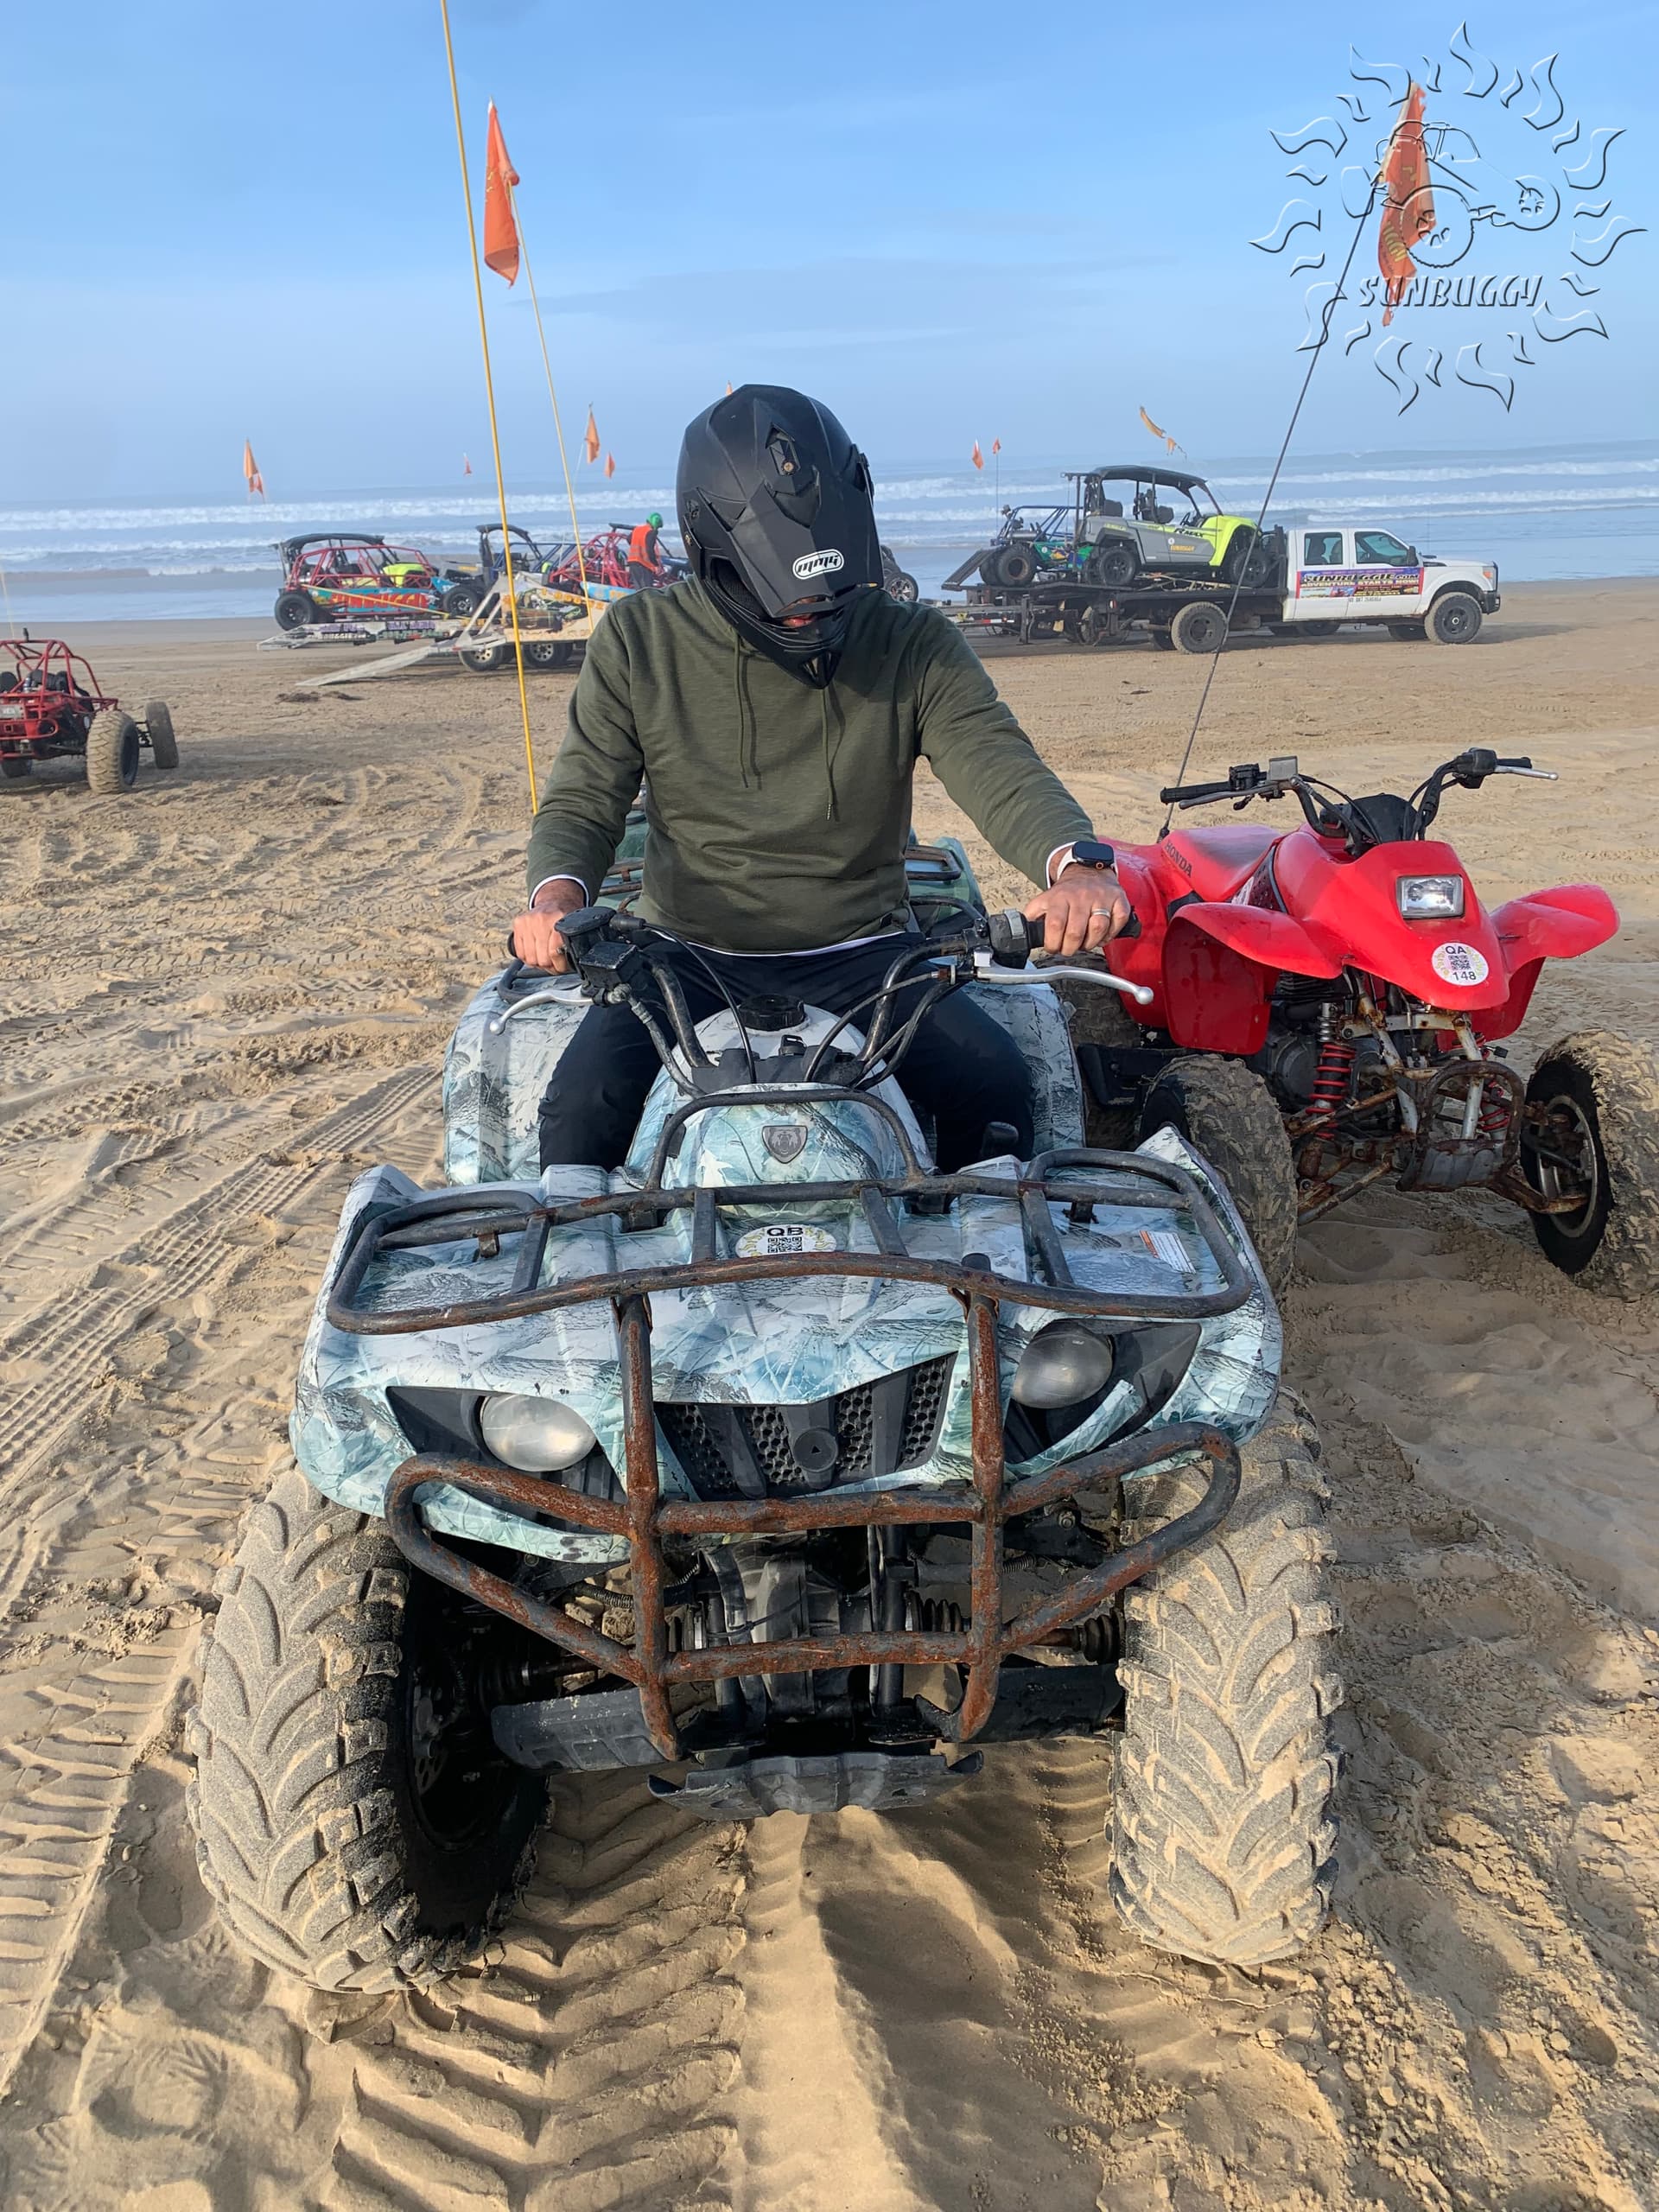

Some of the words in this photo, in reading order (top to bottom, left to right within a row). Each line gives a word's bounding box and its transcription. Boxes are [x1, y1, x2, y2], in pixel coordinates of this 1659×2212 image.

[1164, 841, 1193, 878] HONDA
[1445, 944, 1467, 955] QA
[1452, 971, 1477, 982] 148
[766, 1226, 804, 1236] QB
